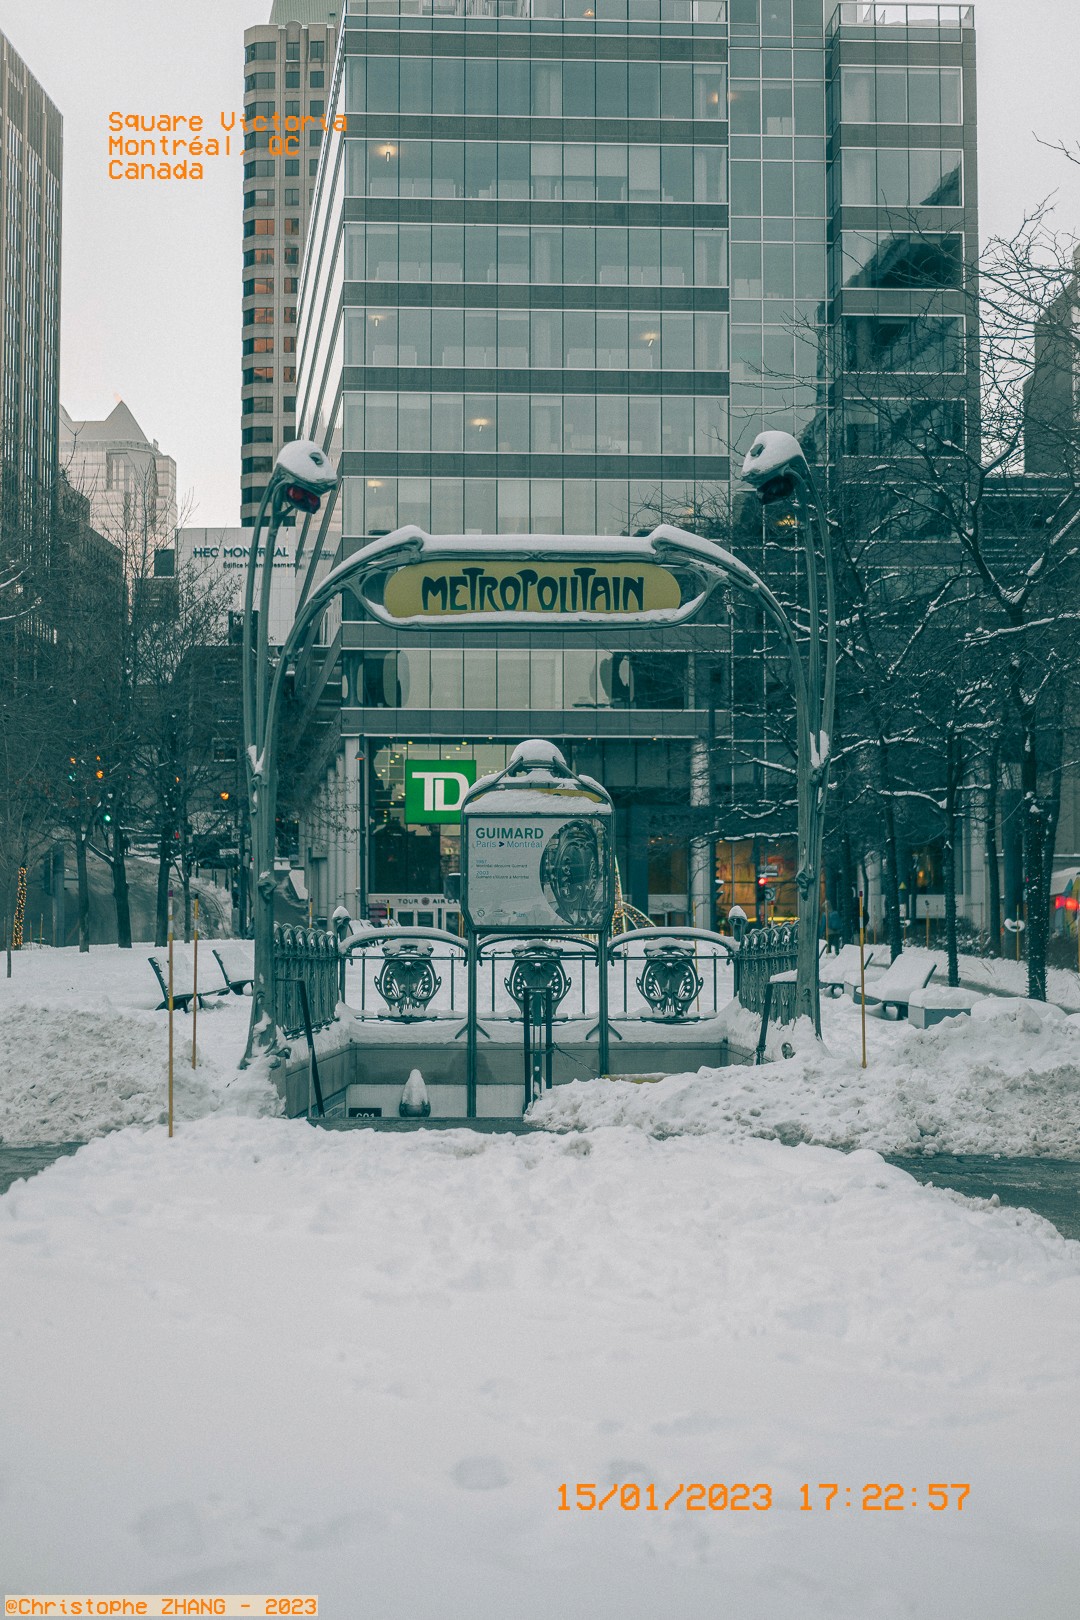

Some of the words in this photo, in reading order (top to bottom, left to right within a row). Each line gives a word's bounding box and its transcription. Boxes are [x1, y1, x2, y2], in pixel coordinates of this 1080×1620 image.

[193, 547, 219, 558] HEC
[223, 547, 289, 558] MONRAL
[223, 561, 243, 569] Édifice
[421, 567, 644, 612] METROPOLITAIN
[412, 772, 470, 811] TD
[475, 827, 544, 839] GUIMARD
[476, 840, 497, 848] Paris
[506, 840, 543, 848] Montréal
